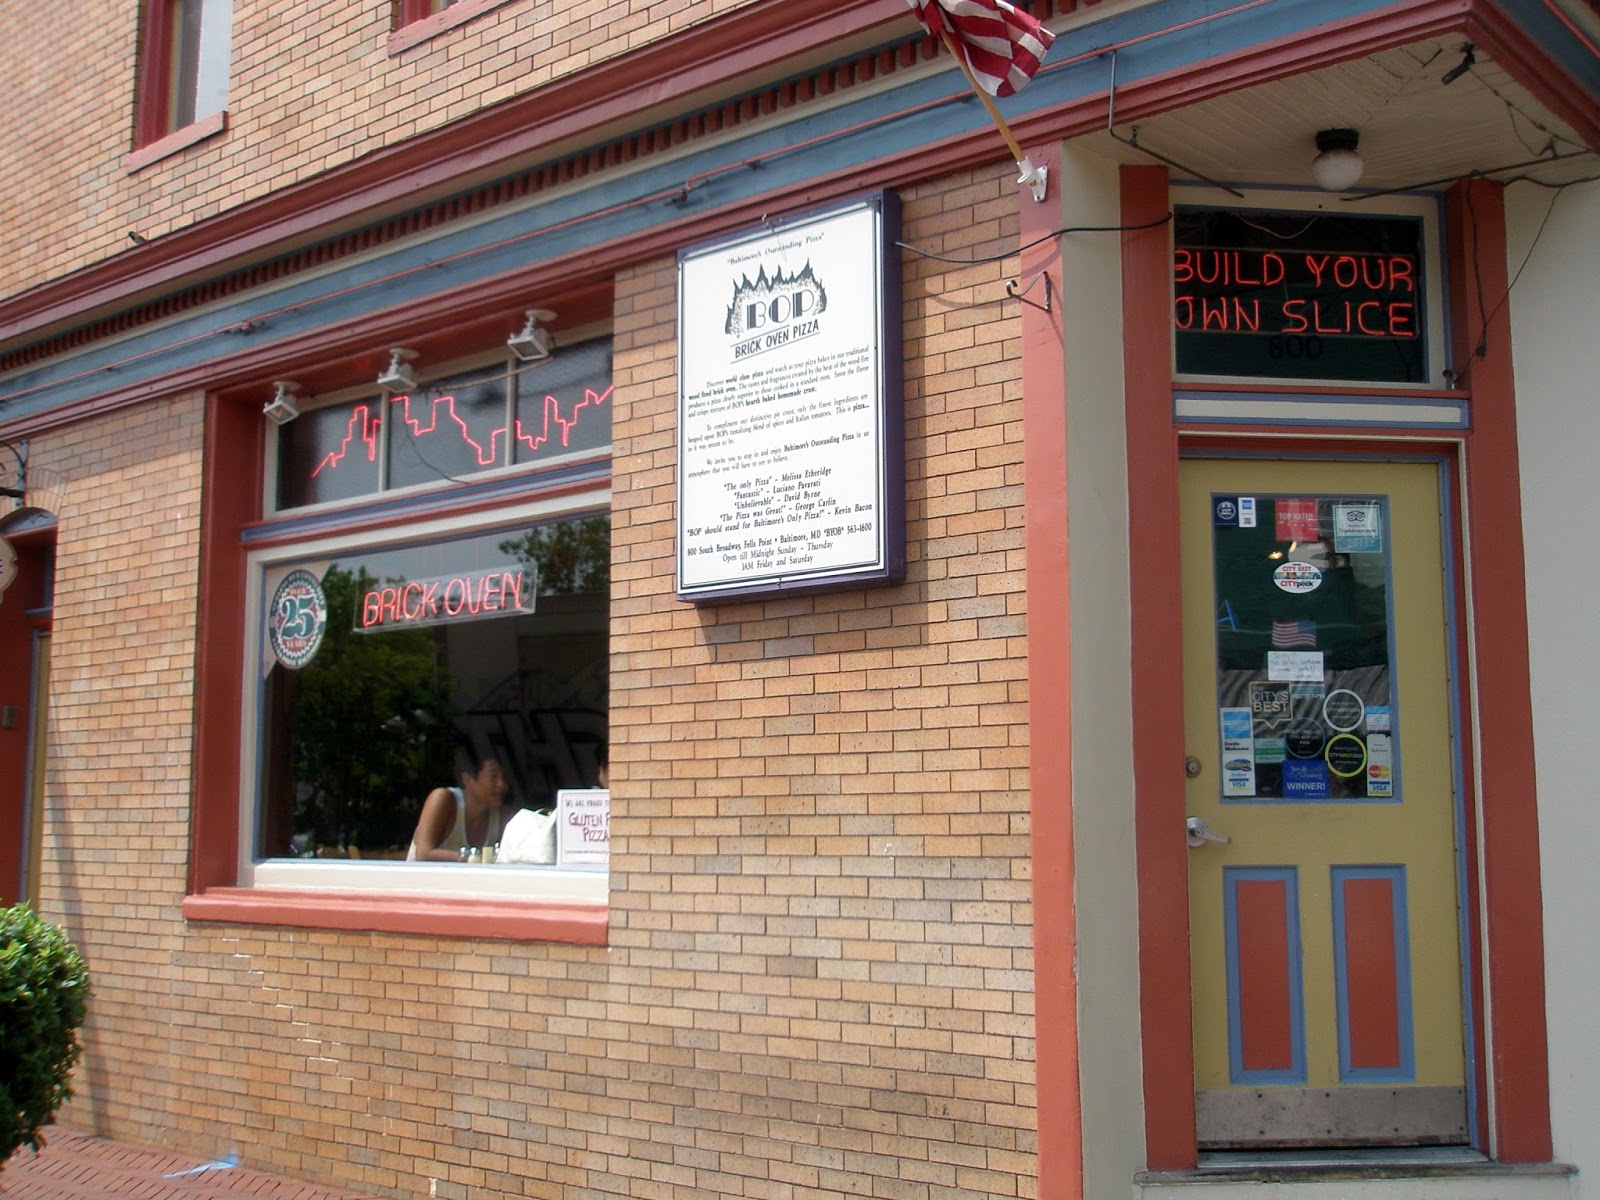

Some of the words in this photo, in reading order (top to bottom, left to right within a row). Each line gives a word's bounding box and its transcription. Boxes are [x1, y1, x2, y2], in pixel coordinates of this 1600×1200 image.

[1175, 250, 1284, 286] BUILD
[1306, 255, 1413, 291] YOUR
[747, 289, 815, 330] BOP
[1175, 296, 1259, 331] OWN
[1282, 300, 1413, 336] SLICE
[734, 338, 762, 360] BRICK
[766, 330, 790, 348] OVEN
[793, 318, 819, 340] PIZZA
[688, 392, 701, 401] wood
[700, 389, 712, 399] fired
[712, 387, 725, 396] brick
[725, 386, 738, 394] oven.
[847, 356, 860, 366] wood
[725, 375, 738, 384] world
[739, 373, 751, 382] class
[751, 371, 764, 380] pizza
[805, 359, 817, 368] pizza
[710, 398, 722, 407] pizza
[745, 397, 761, 407] hearth
[762, 393, 776, 403] baked
[777, 388, 802, 400] homemade
[803, 386, 817, 395] crust.
[784, 441, 809, 453] Baltimore's
[810, 436, 840, 448] Outstanding
[841, 433, 855, 442] Pizza
[739, 480, 752, 490] only
[781, 472, 802, 482] Melissa
[804, 466, 832, 479] Etheridge
[773, 484, 795, 494] Luciano
[797, 478, 821, 490] Pavarati
[735, 512, 750, 521] Pizza
[795, 500, 815, 512] George
[817, 497, 837, 508] Carlin
[783, 492, 801, 503] David
[803, 491, 821, 501] Byrne
[704, 525, 722, 535] should
[725, 522, 740, 532] stand
[742, 521, 751, 530] for
[754, 515, 784, 528] Baltimore's
[787, 513, 802, 523] Only
[834, 505, 851, 516] Kevin
[854, 504, 872, 513] Bacon
[1279, 512, 1292, 520] TOP
[1293, 513, 1313, 521] RATED
[687, 547, 697, 557] 800
[699, 545, 714, 555] South
[716, 542, 742, 553] Broadway,
[744, 539, 756, 549] Fells
[758, 538, 772, 547] Point
[780, 534, 809, 544] Baltimore,
[847, 522, 872, 535] 563-1600
[722, 554, 737, 564] Open
[739, 551, 748, 561] till
[750, 548, 775, 559] Midnight
[777, 545, 798, 556] Sunday
[806, 540, 834, 552] Thursday
[756, 559, 774, 569] Friday
[776, 557, 787, 567] and
[789, 554, 814, 565] Saturday
[363, 581, 440, 627] BRICK
[444, 572, 522, 616] OVEN
[280, 594, 317, 639] 25
[1252, 690, 1289, 701] CITY'S
[1253, 701, 1289, 712] BEST
[1286, 782, 1326, 791] WINNER!
[569, 811, 602, 827] GLUTEN
[582, 827, 609, 842] PIZZA
